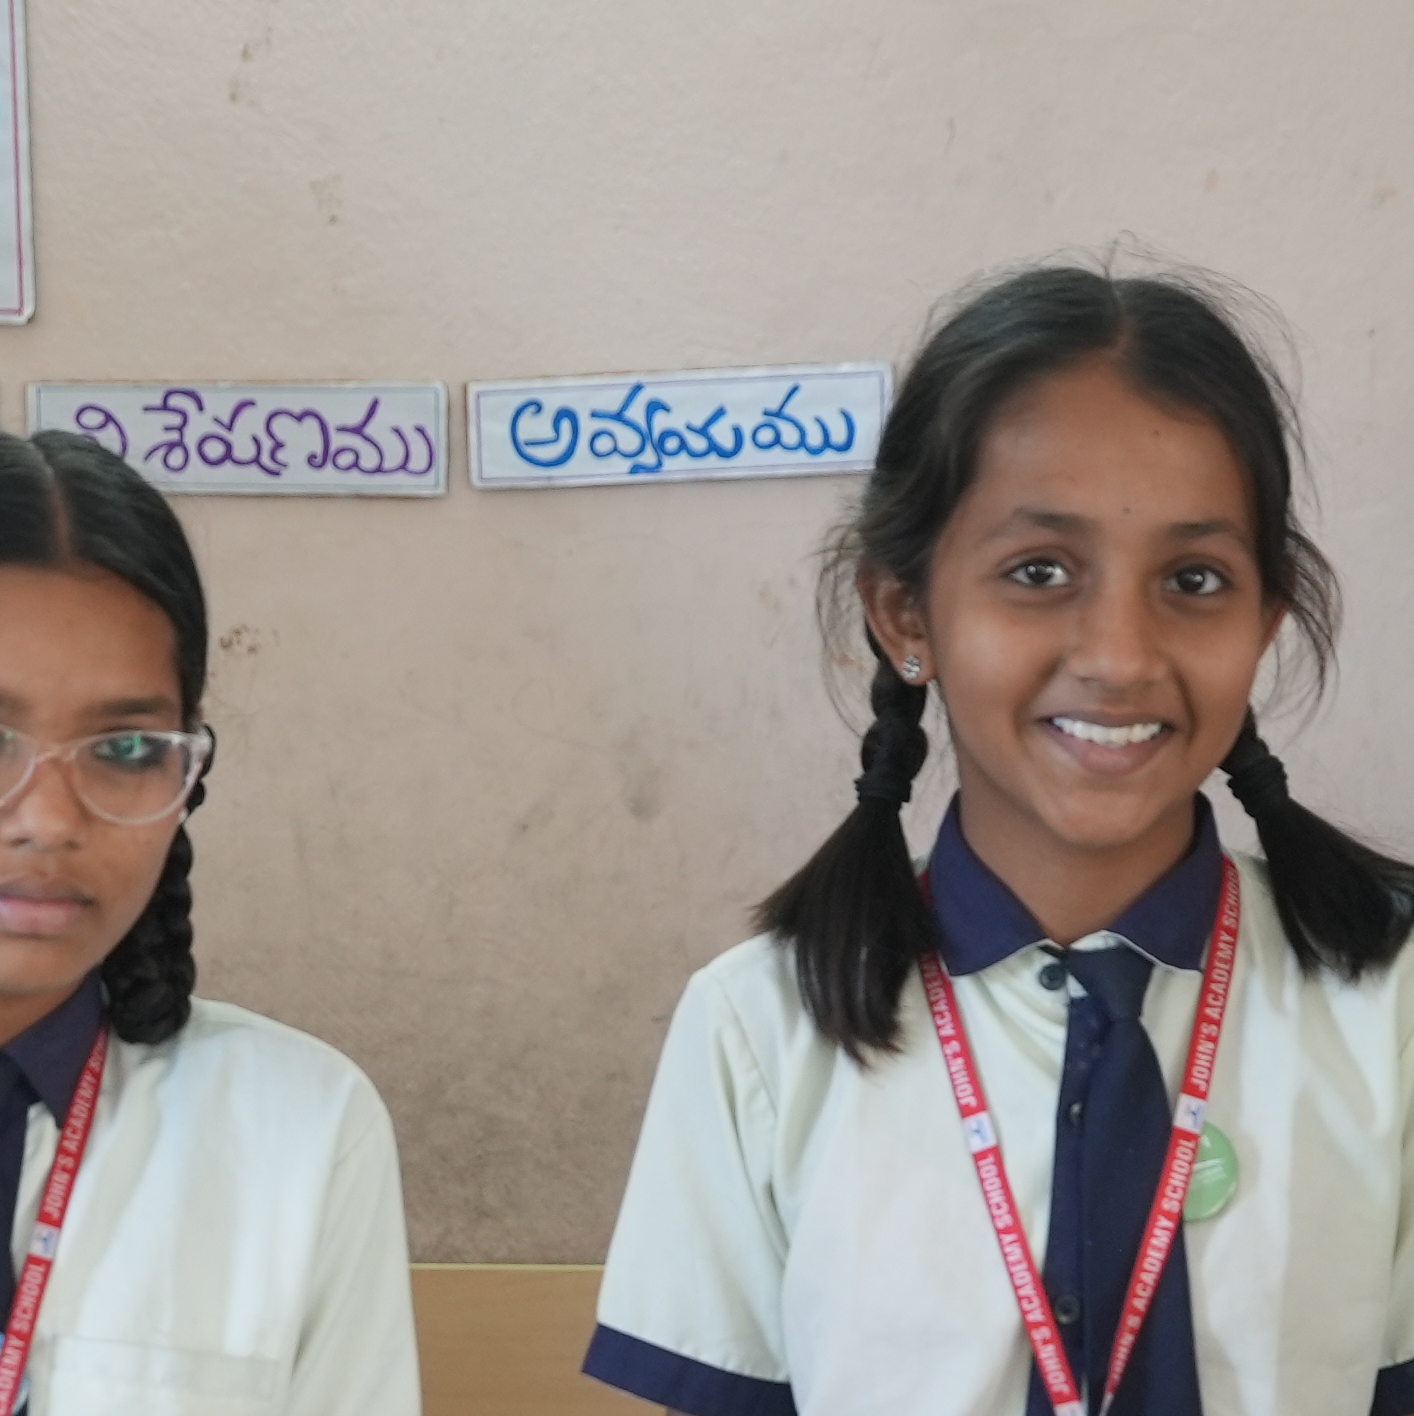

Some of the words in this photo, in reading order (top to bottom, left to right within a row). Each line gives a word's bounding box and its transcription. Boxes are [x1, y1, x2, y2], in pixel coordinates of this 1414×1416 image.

[1202, 929, 1236, 1019] ACADEMY
[940, 1038, 980, 1110] JOHN'S
[1188, 1021, 1219, 1091] JOHN'S
[975, 1153, 1015, 1230] SCHOOL
[1129, 1214, 1175, 1313] ACADEMY
[1157, 1135, 1199, 1214] SCHOOL
[11, 1262, 44, 1333] SCHOOL
[999, 1229, 1045, 1326] ACADEMY
[1030, 1323, 1070, 1398] JOHN'S
